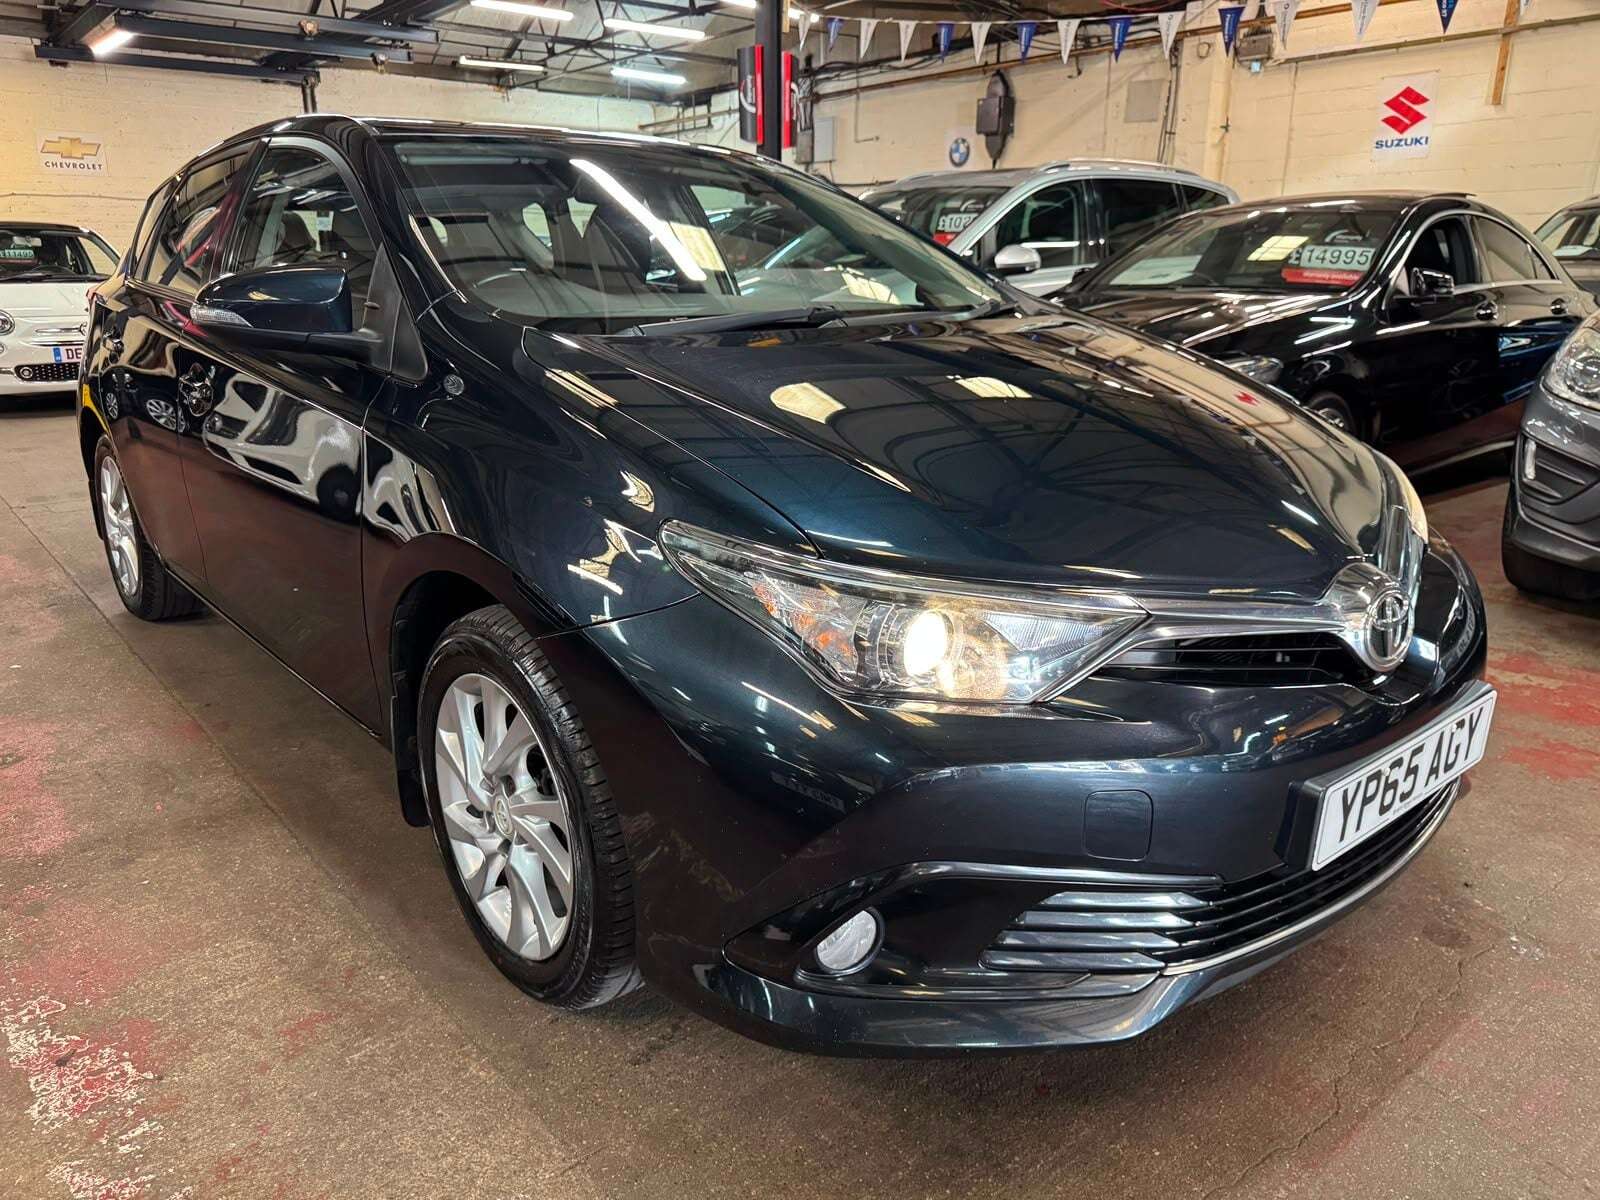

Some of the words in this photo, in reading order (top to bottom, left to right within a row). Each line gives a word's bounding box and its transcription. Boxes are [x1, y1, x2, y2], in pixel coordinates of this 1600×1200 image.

[1375, 136, 1429, 149] SUZUKI
[44, 160, 103, 171] CHEVROLET
[1288, 247, 1372, 266] £14995
[1338, 743, 1426, 843] YP65
[1425, 707, 1484, 788] AGY
